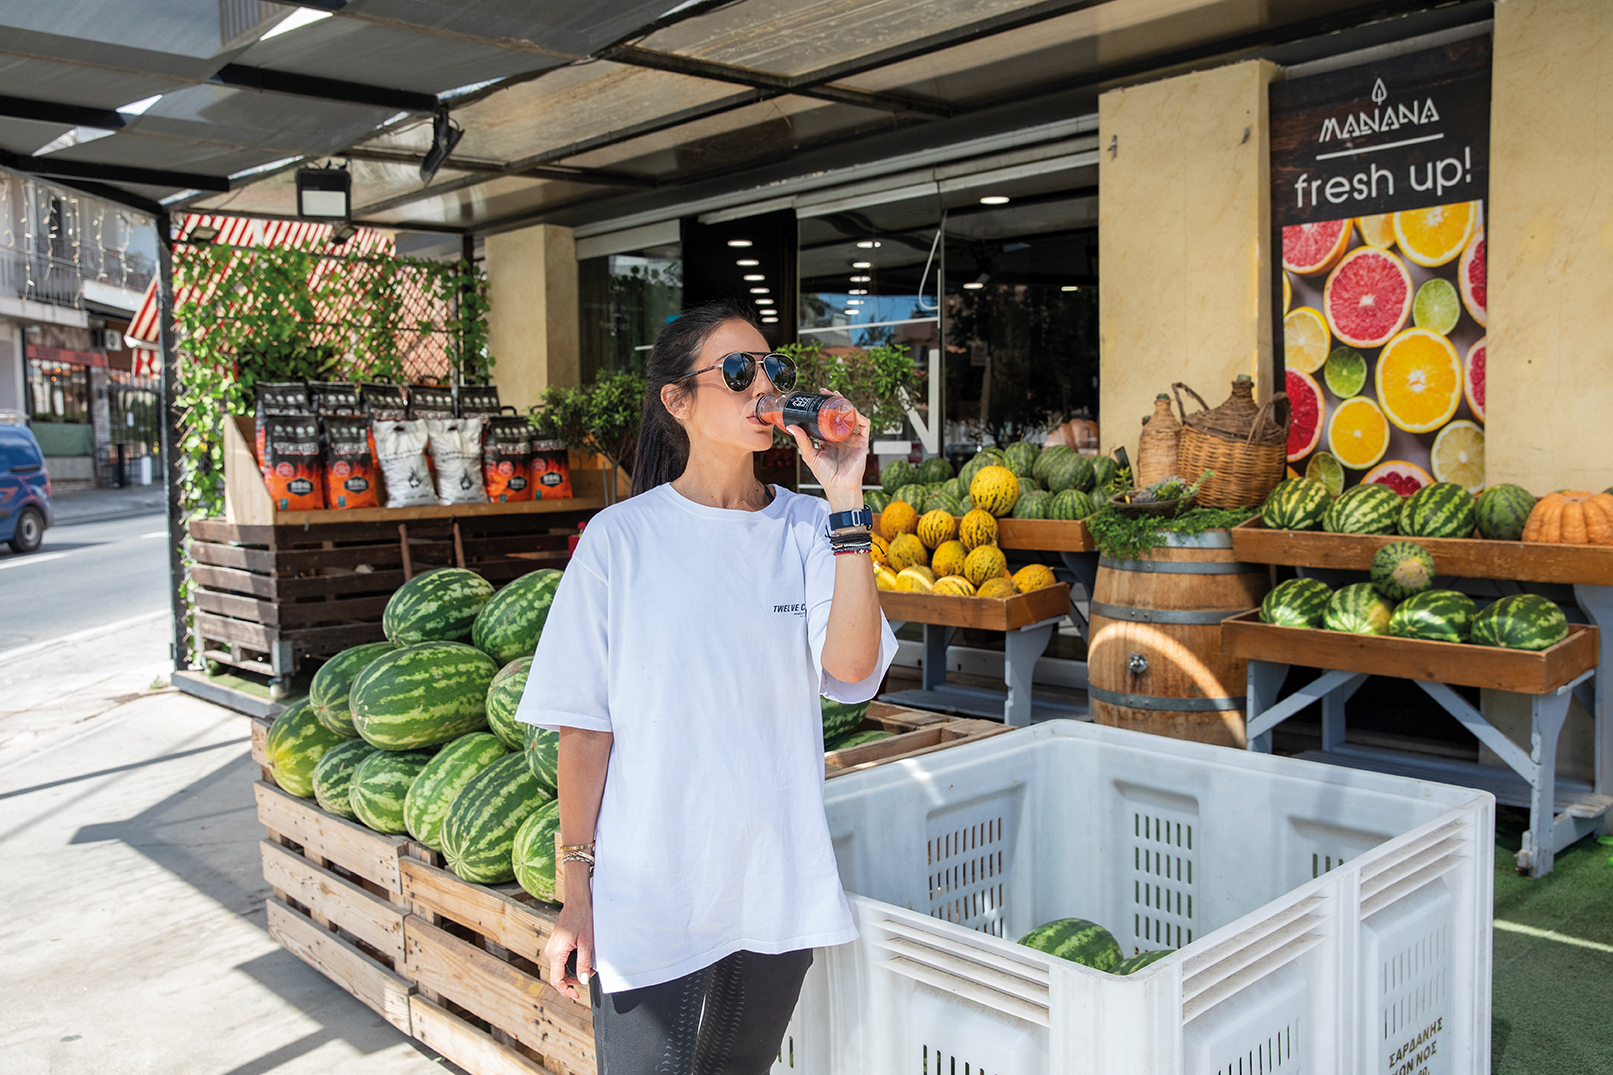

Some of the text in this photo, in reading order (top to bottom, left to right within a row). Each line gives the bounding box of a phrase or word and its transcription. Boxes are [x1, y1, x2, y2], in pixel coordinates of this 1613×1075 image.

[1294, 146, 1472, 208] fresh up!
[773, 603, 799, 613] TWELVE
[1389, 1016, 1443, 1069] ΣΑΡΔΑΝΗΣ
